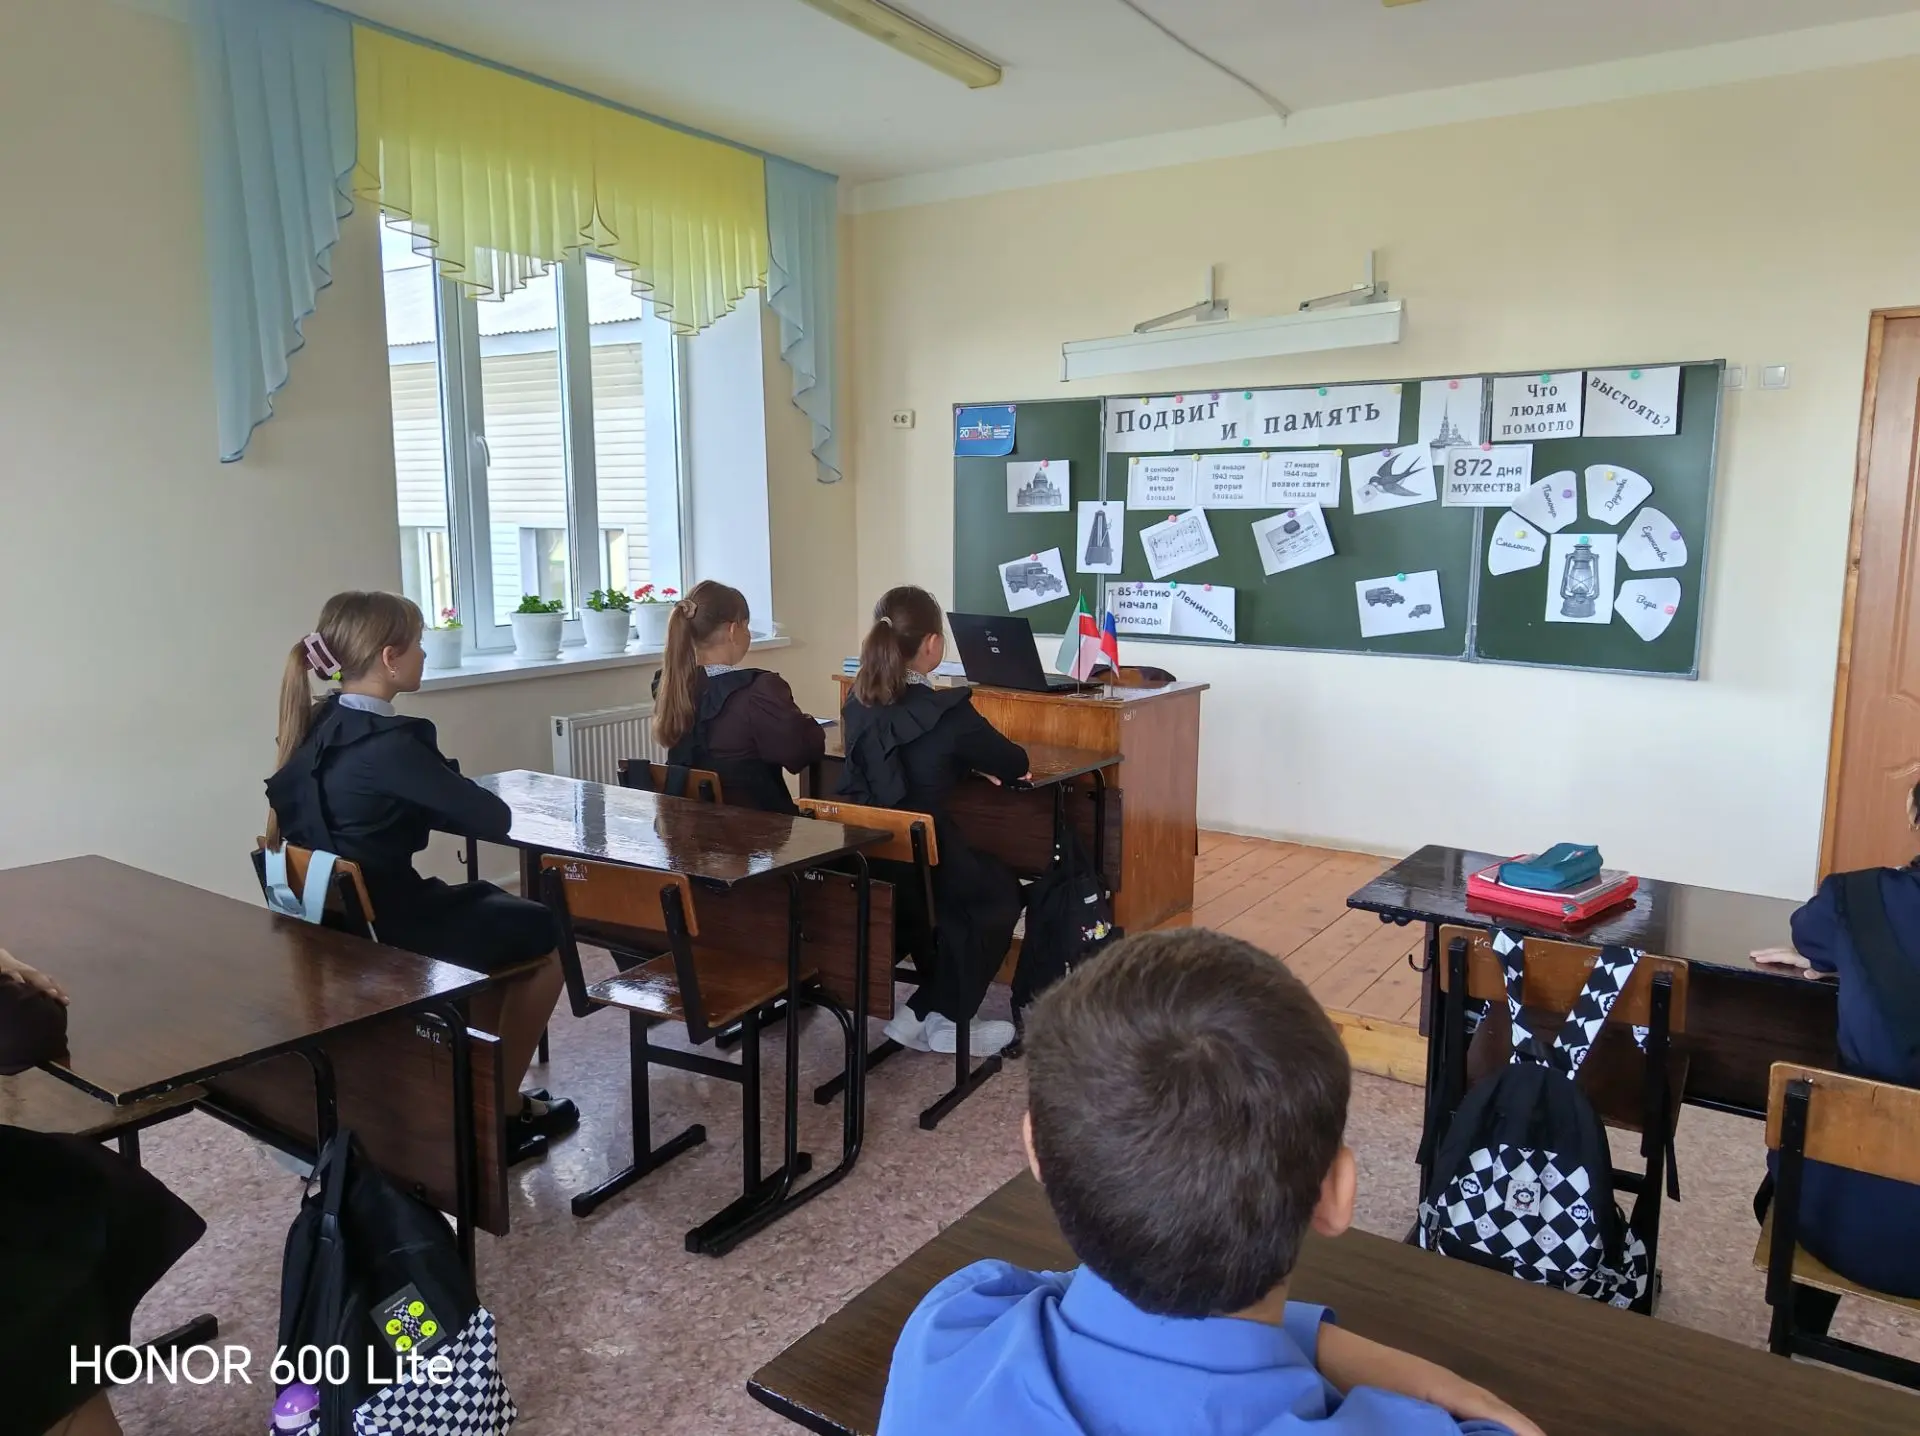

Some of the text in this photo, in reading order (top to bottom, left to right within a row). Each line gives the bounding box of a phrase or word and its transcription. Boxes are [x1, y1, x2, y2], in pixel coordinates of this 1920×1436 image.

[1527, 384, 1558, 398] Что
[1509, 402, 1568, 417] людям
[1589, 377, 1671, 429] выстоять?
[1115, 401, 1219, 434] Подвиг
[1221, 402, 1381, 441] и память
[1501, 419, 1575, 436] помогло
[1284, 461, 1293, 469] 27
[1453, 458, 1523, 478] 872 дня
[1451, 480, 1522, 497] мужества
[1117, 587, 1171, 598] 85-летию
[1119, 601, 1158, 610] начала
[1176, 590, 1233, 635] Ленинграда
[1114, 614, 1162, 626] блокады
